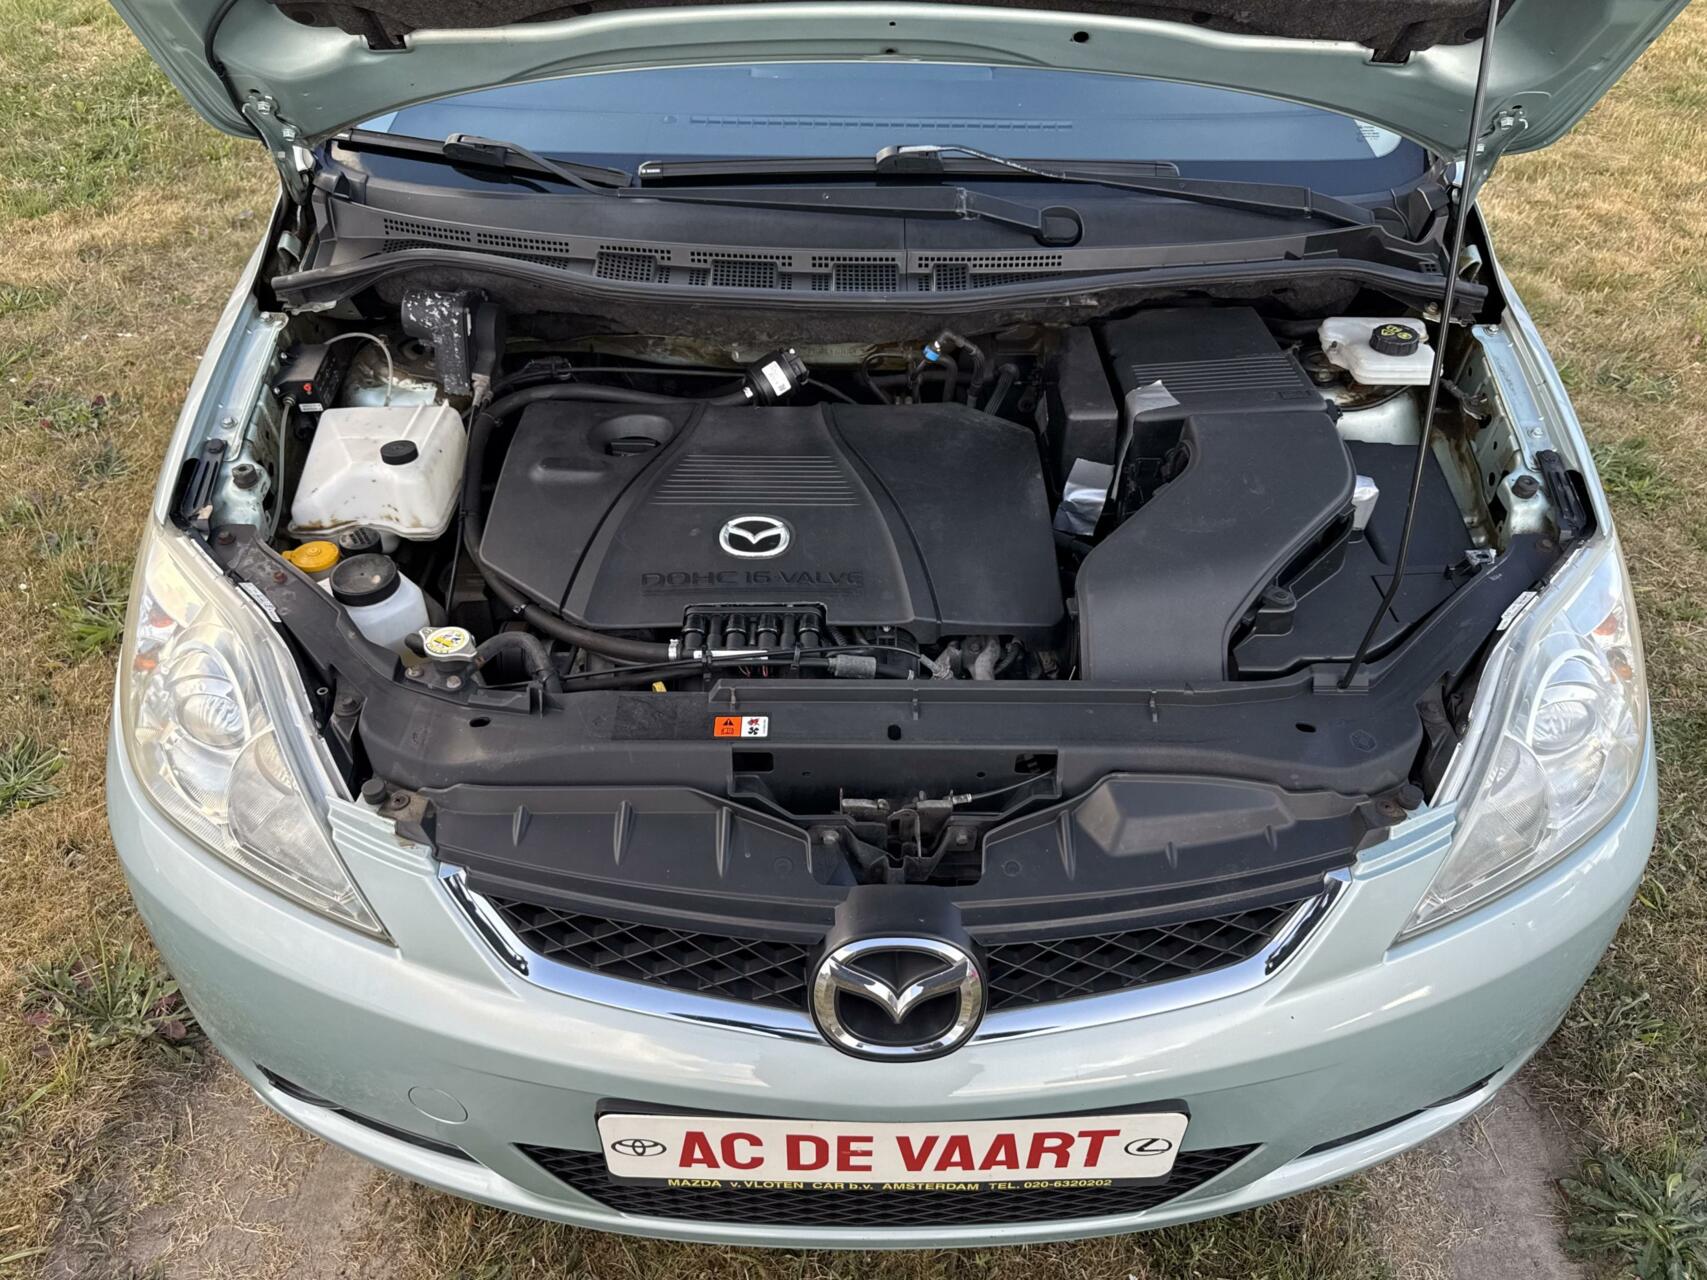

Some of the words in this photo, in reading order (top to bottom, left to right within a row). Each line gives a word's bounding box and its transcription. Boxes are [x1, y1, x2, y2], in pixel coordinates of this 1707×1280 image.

[641, 571, 738, 586] DOHC
[744, 571, 771, 584] 16
[678, 1131, 765, 1170] AC
[786, 1134, 874, 1172] DE
[895, 1129, 1121, 1172] VAART
[667, 1178, 722, 1188] MAZDA
[812, 1182, 845, 1190] CAR
[882, 1182, 979, 1191] AMSTERDAM
[988, 1181, 1020, 1190] TEL.
[1023, 1179, 1112, 1189] 020-6320202
